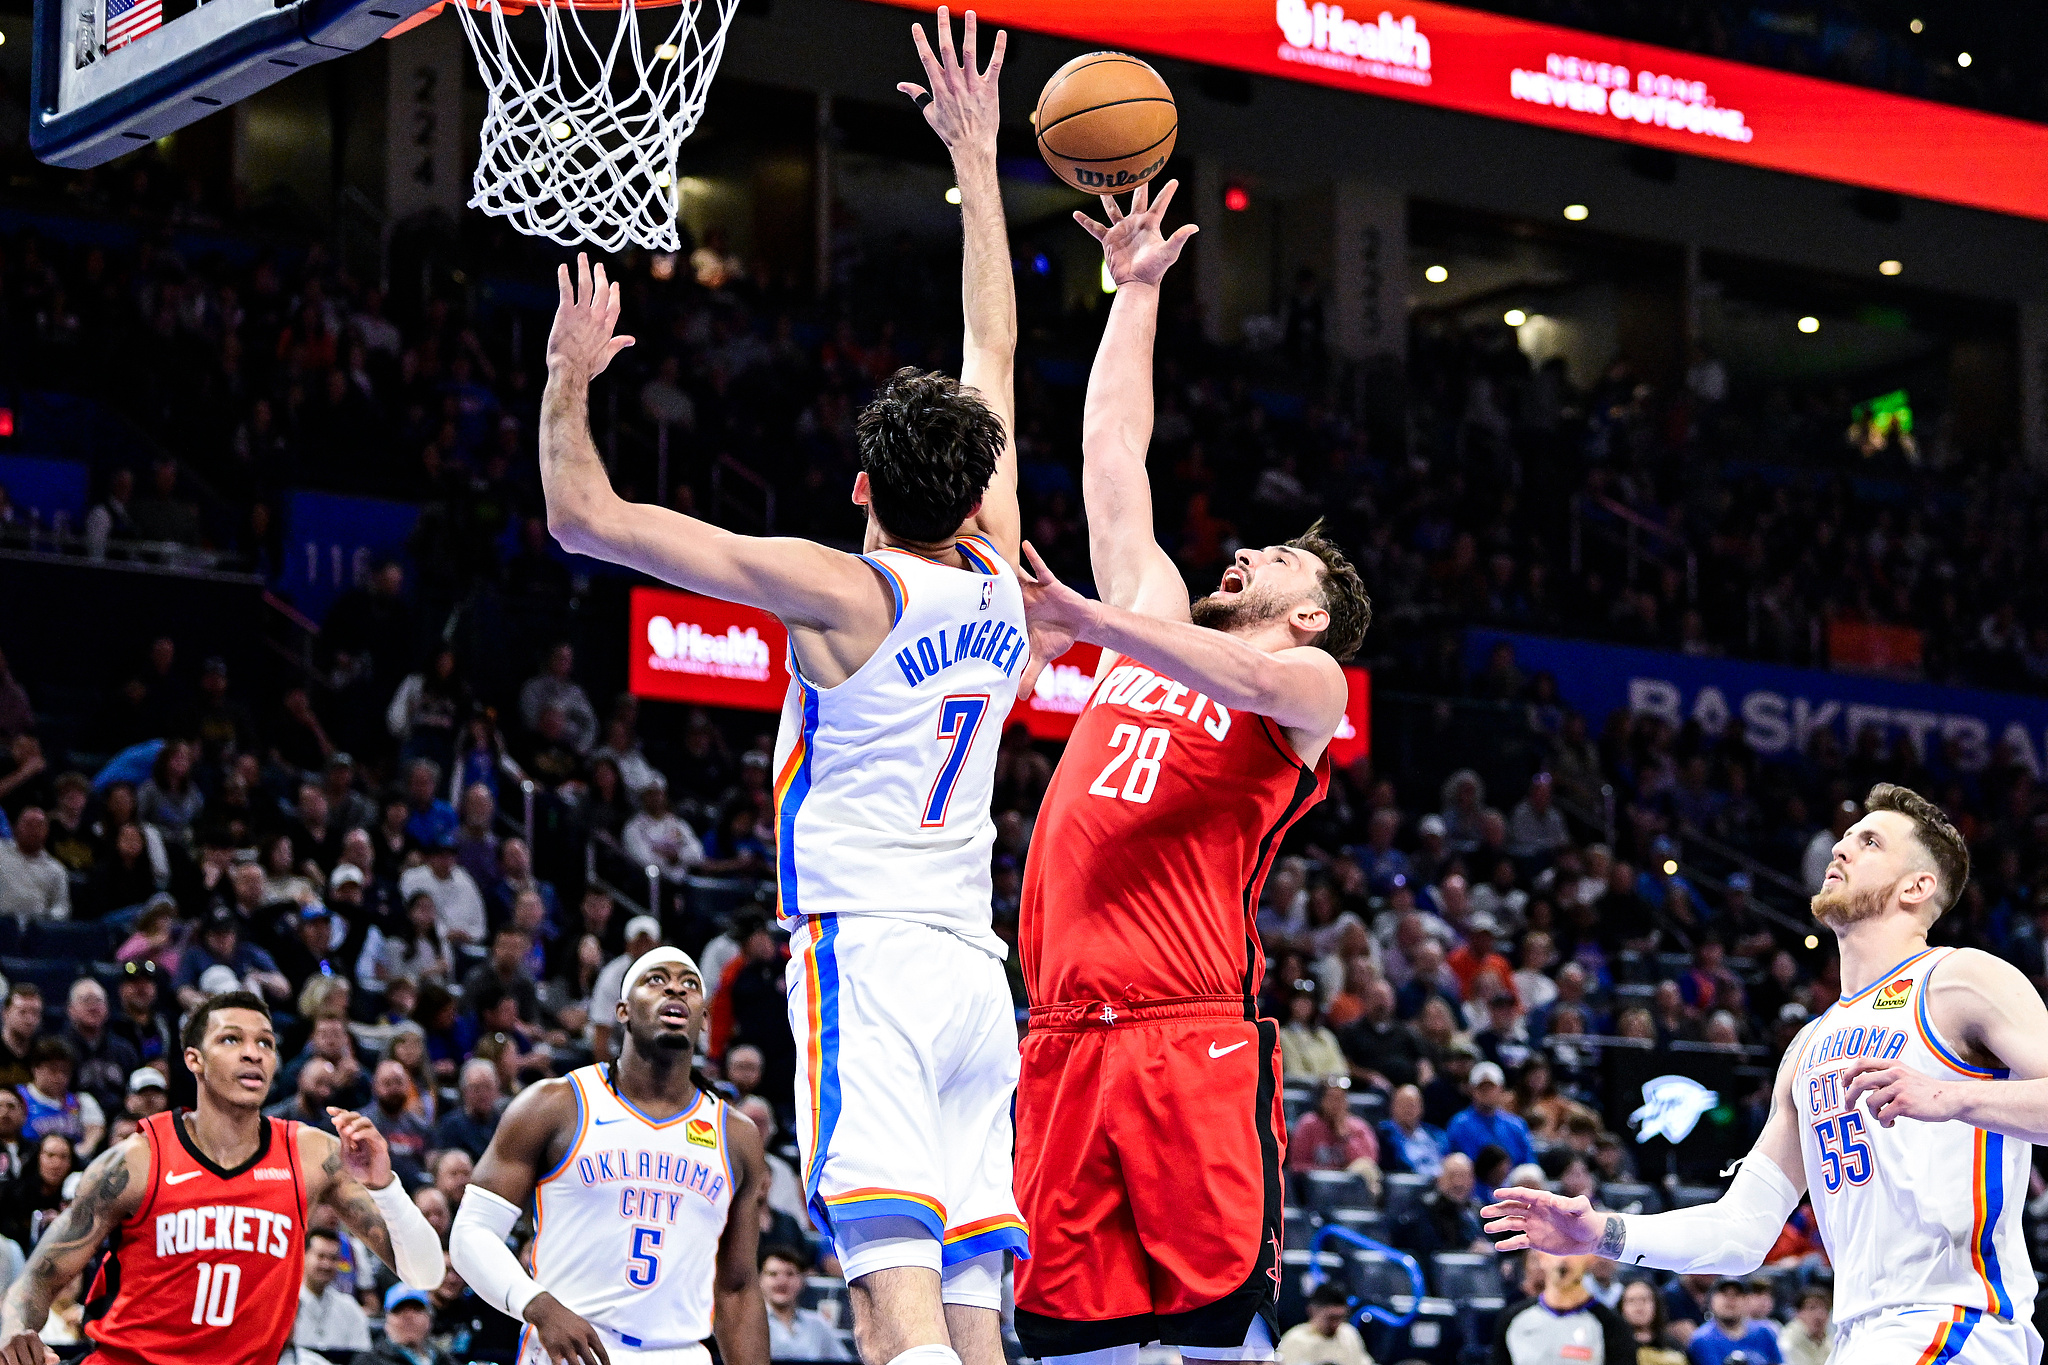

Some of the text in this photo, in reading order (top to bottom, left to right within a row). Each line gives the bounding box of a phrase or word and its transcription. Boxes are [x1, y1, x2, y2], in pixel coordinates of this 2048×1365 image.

[1312, 2, 1431, 70] Health
[1074, 156, 1165, 187] Wilson
[895, 619, 1026, 688] HOLMGREN
[1091, 665, 1232, 742] ROCETS
[1627, 676, 2048, 781] BASKETBA
[920, 693, 990, 828] 7
[1088, 723, 1171, 804] 28
[1798, 1025, 1908, 1083] LAHOMA
[1809, 1068, 1850, 1116] CIT
[576, 1149, 726, 1205] OKLAHOMA
[1812, 1109, 1874, 1194] 55
[156, 1205, 293, 1259] ROCKETS
[619, 1186, 684, 1225] CITY
[625, 1223, 665, 1290] 5
[191, 1262, 242, 1327] 10
